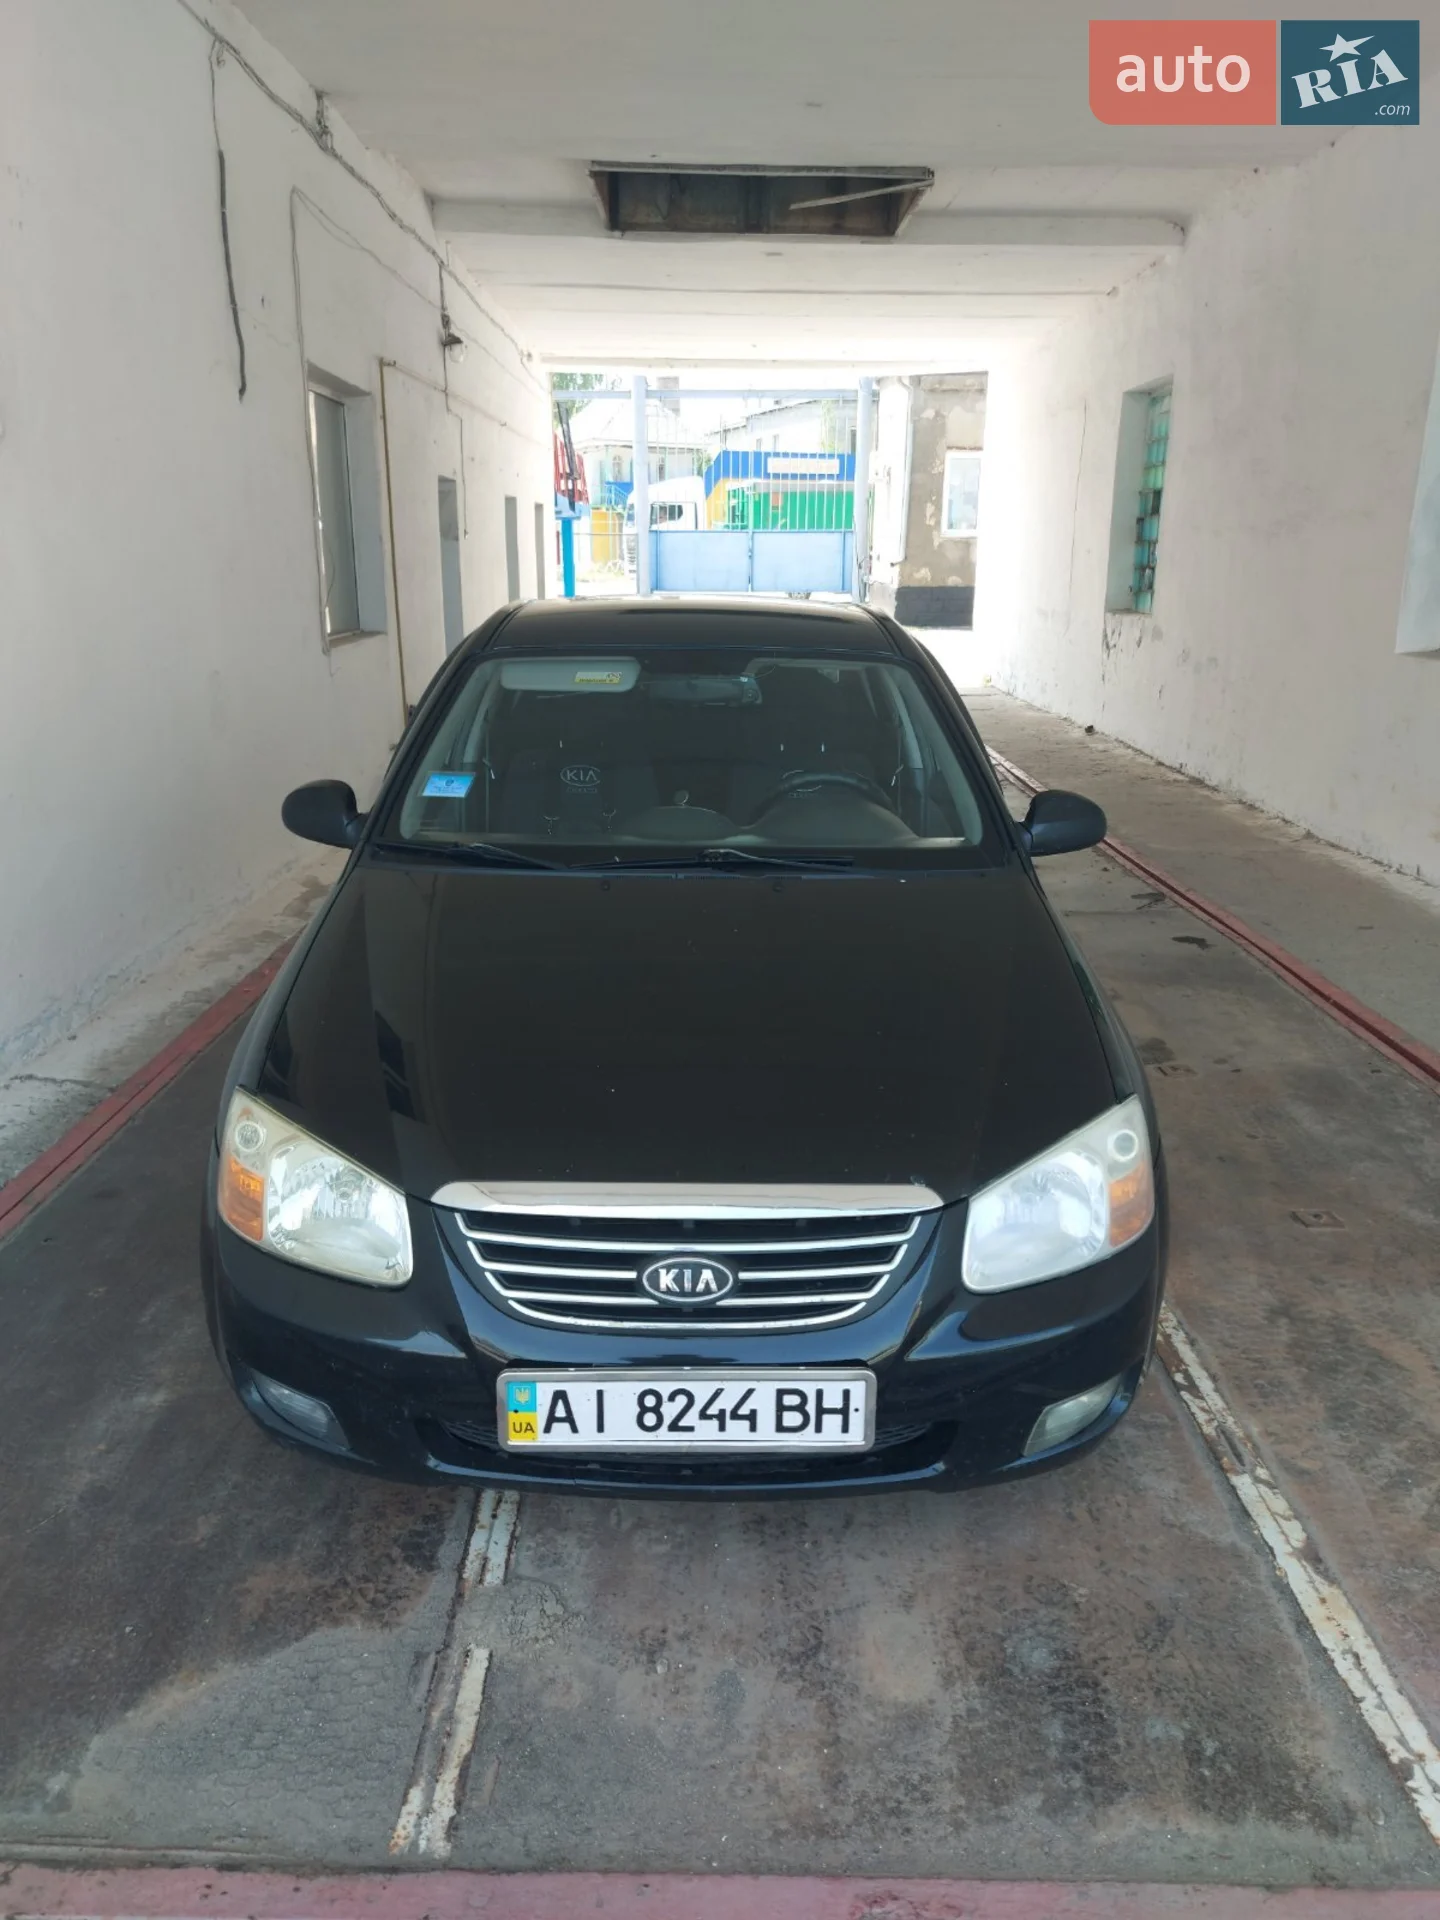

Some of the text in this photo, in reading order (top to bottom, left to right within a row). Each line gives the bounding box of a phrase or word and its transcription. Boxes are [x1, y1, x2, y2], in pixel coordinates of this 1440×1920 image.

[566, 769, 598, 781] KIA
[658, 1268, 718, 1292] KIA
[543, 1387, 851, 1434] AI 8244 BH
[512, 1422, 535, 1434] UA
